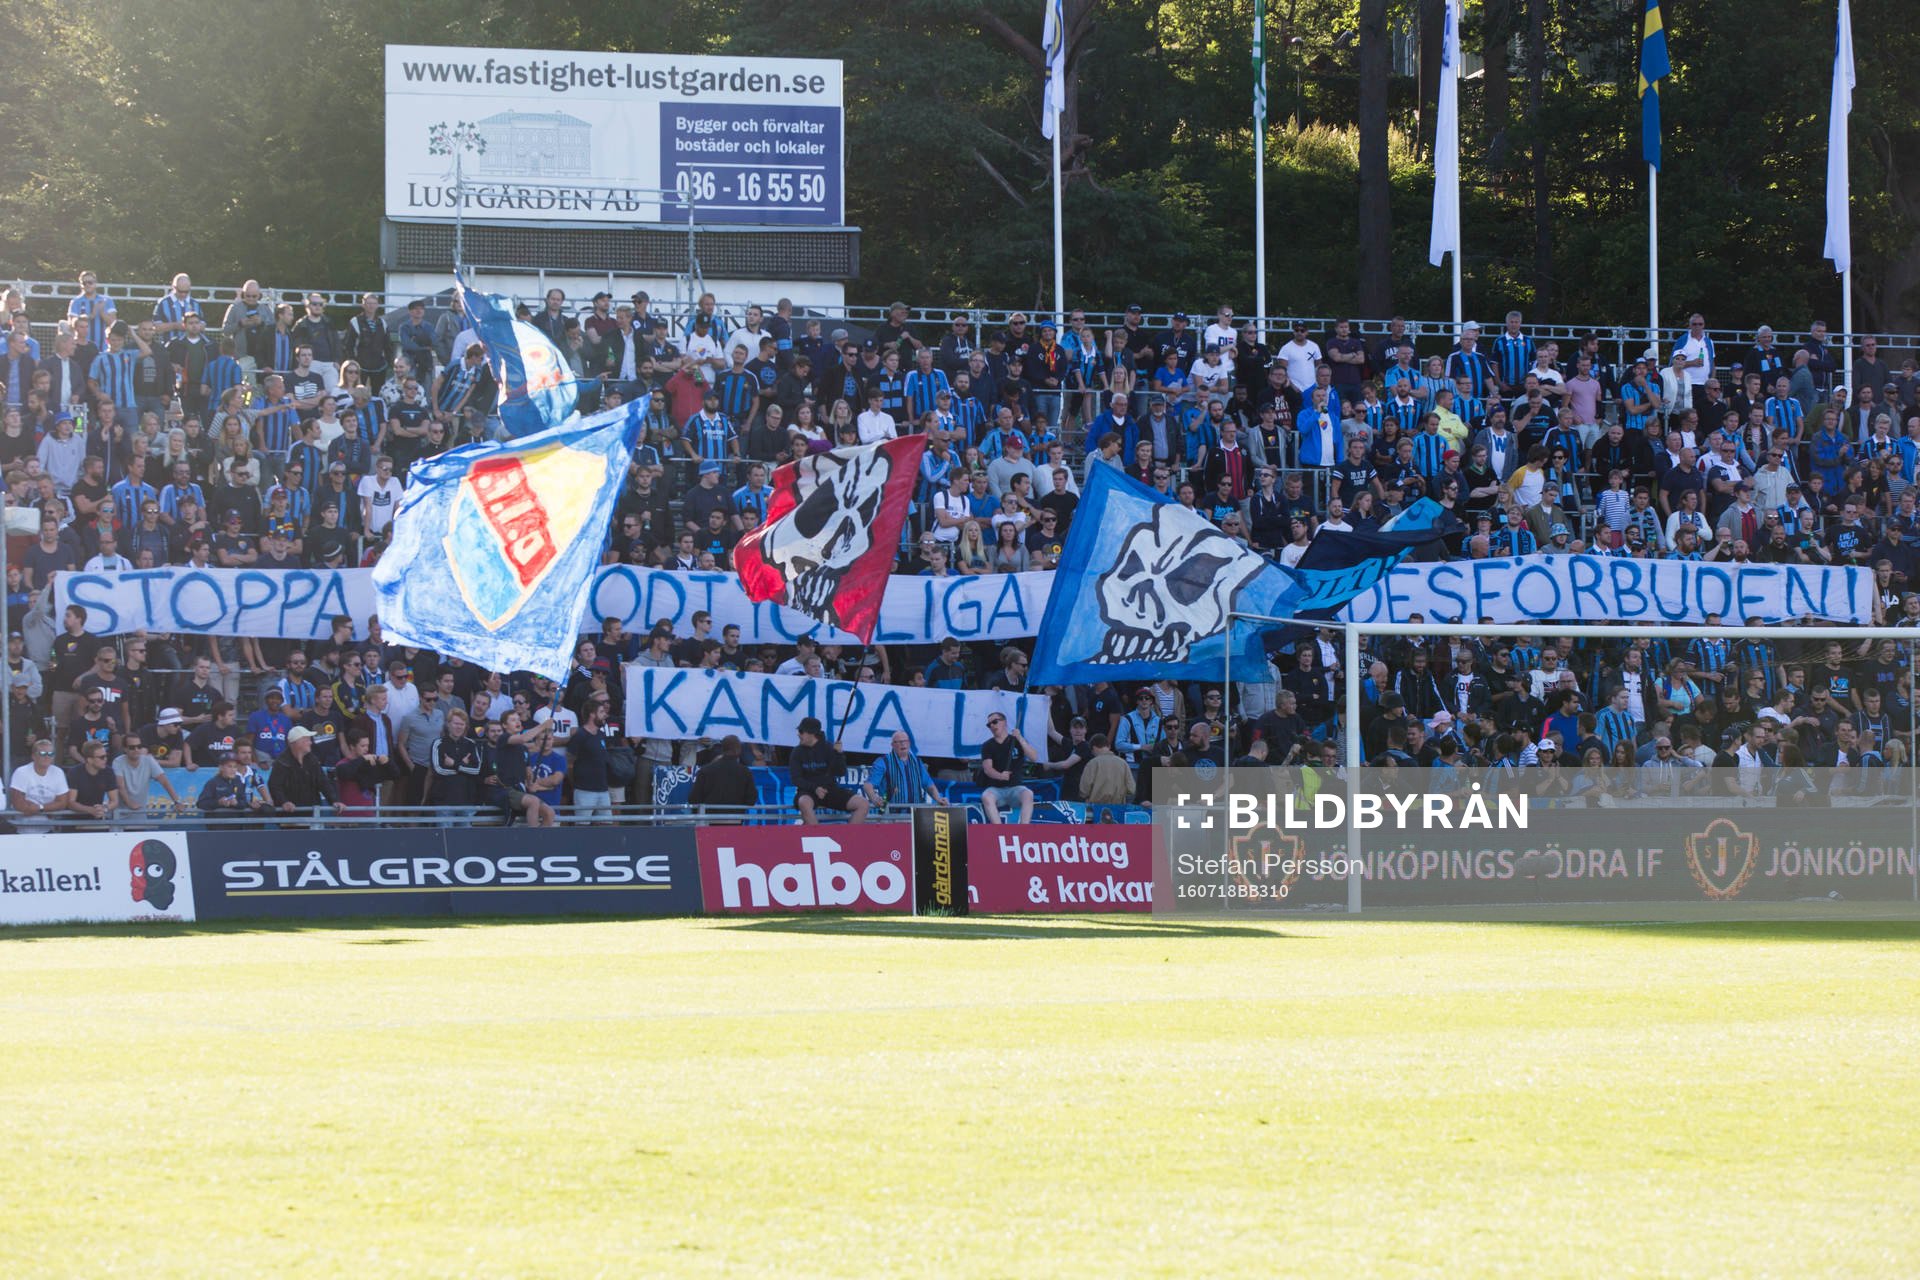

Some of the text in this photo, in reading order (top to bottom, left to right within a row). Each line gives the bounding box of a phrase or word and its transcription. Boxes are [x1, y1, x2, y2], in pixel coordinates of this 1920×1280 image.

[403, 58, 826, 95] www.fastighet-lustgarden.se
[676, 116, 824, 134] Bygger och förvaltar
[676, 137, 825, 155] bostäder och lokaler
[676, 171, 716, 201] 036
[737, 172, 761, 202] 16
[768, 173, 793, 202] 55
[799, 174, 825, 203] 50
[67, 570, 357, 637] STOPPA
[643, 668, 919, 754] KÄMPA
[222, 851, 671, 886] STÅLGROSS.SE
[932, 811, 950, 905] gårdsman
[998, 835, 1129, 869] Handtag
[1637, 848, 1664, 878] IF
[1765, 840, 1920, 877] JÖNKÖPIN
[0, 866, 102, 893] kallen!
[717, 836, 906, 908] habo
[1027, 875, 1154, 903] & krokar
